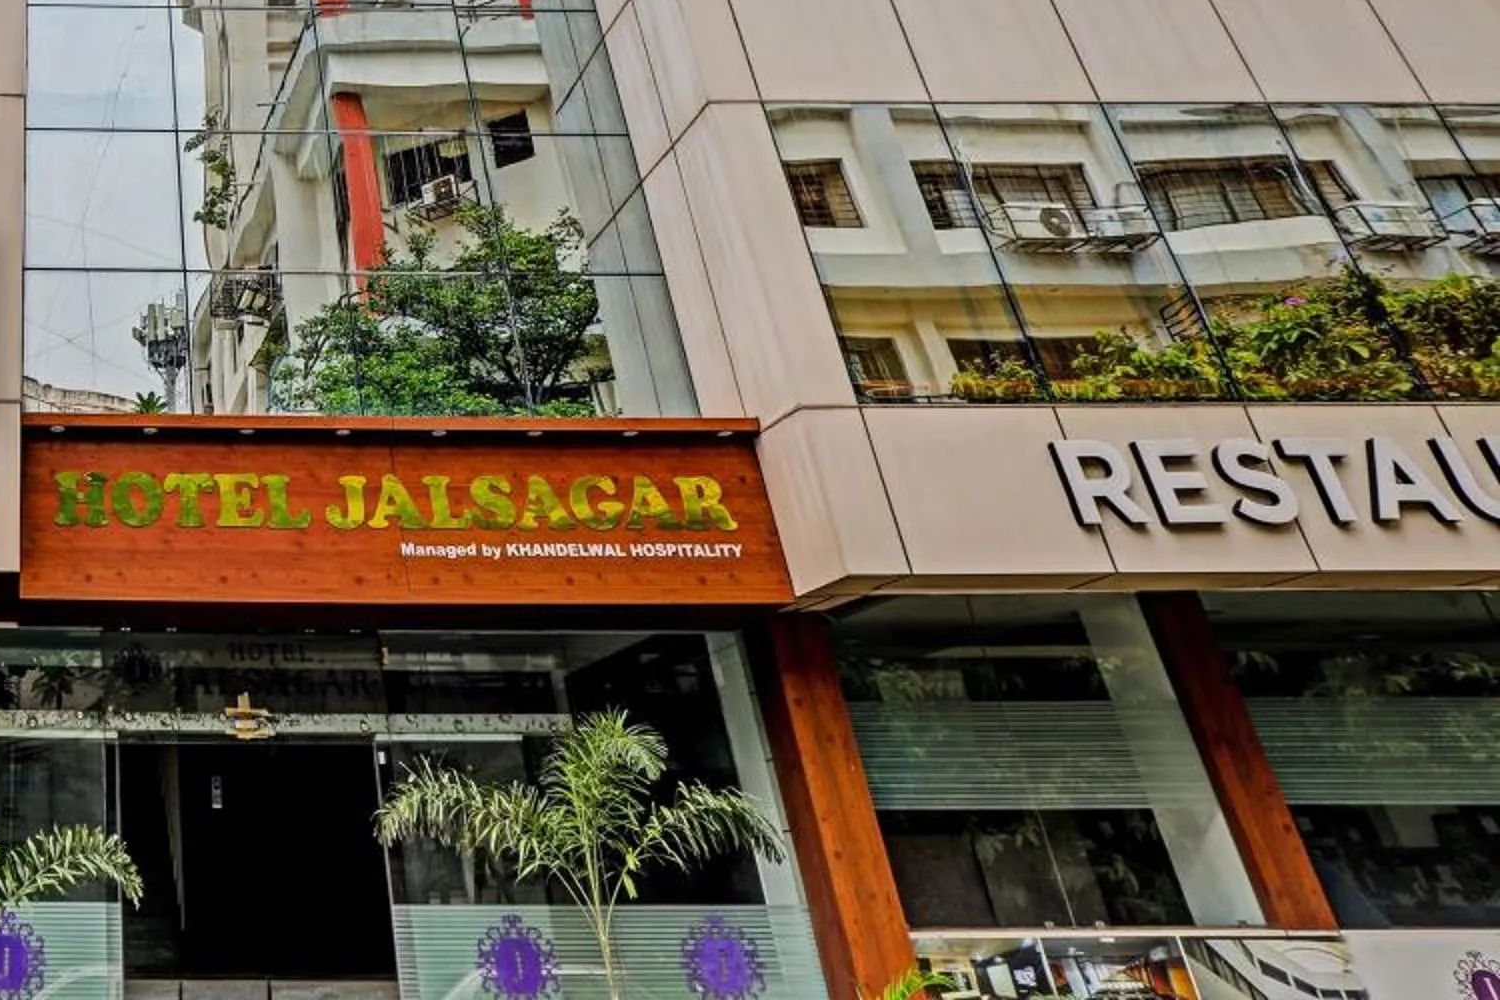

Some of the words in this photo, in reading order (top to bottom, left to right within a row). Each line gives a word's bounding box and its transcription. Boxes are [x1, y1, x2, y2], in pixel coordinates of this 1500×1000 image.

[53, 470, 311, 530] HOTEL
[325, 473, 738, 532] JALSAGAR
[1047, 437, 1500, 530] RESTAU
[400, 543, 476, 558] Managed
[481, 543, 501, 558] by
[506, 543, 627, 558] KHANDELWAL
[630, 543, 743, 558] HOSPITALITY
